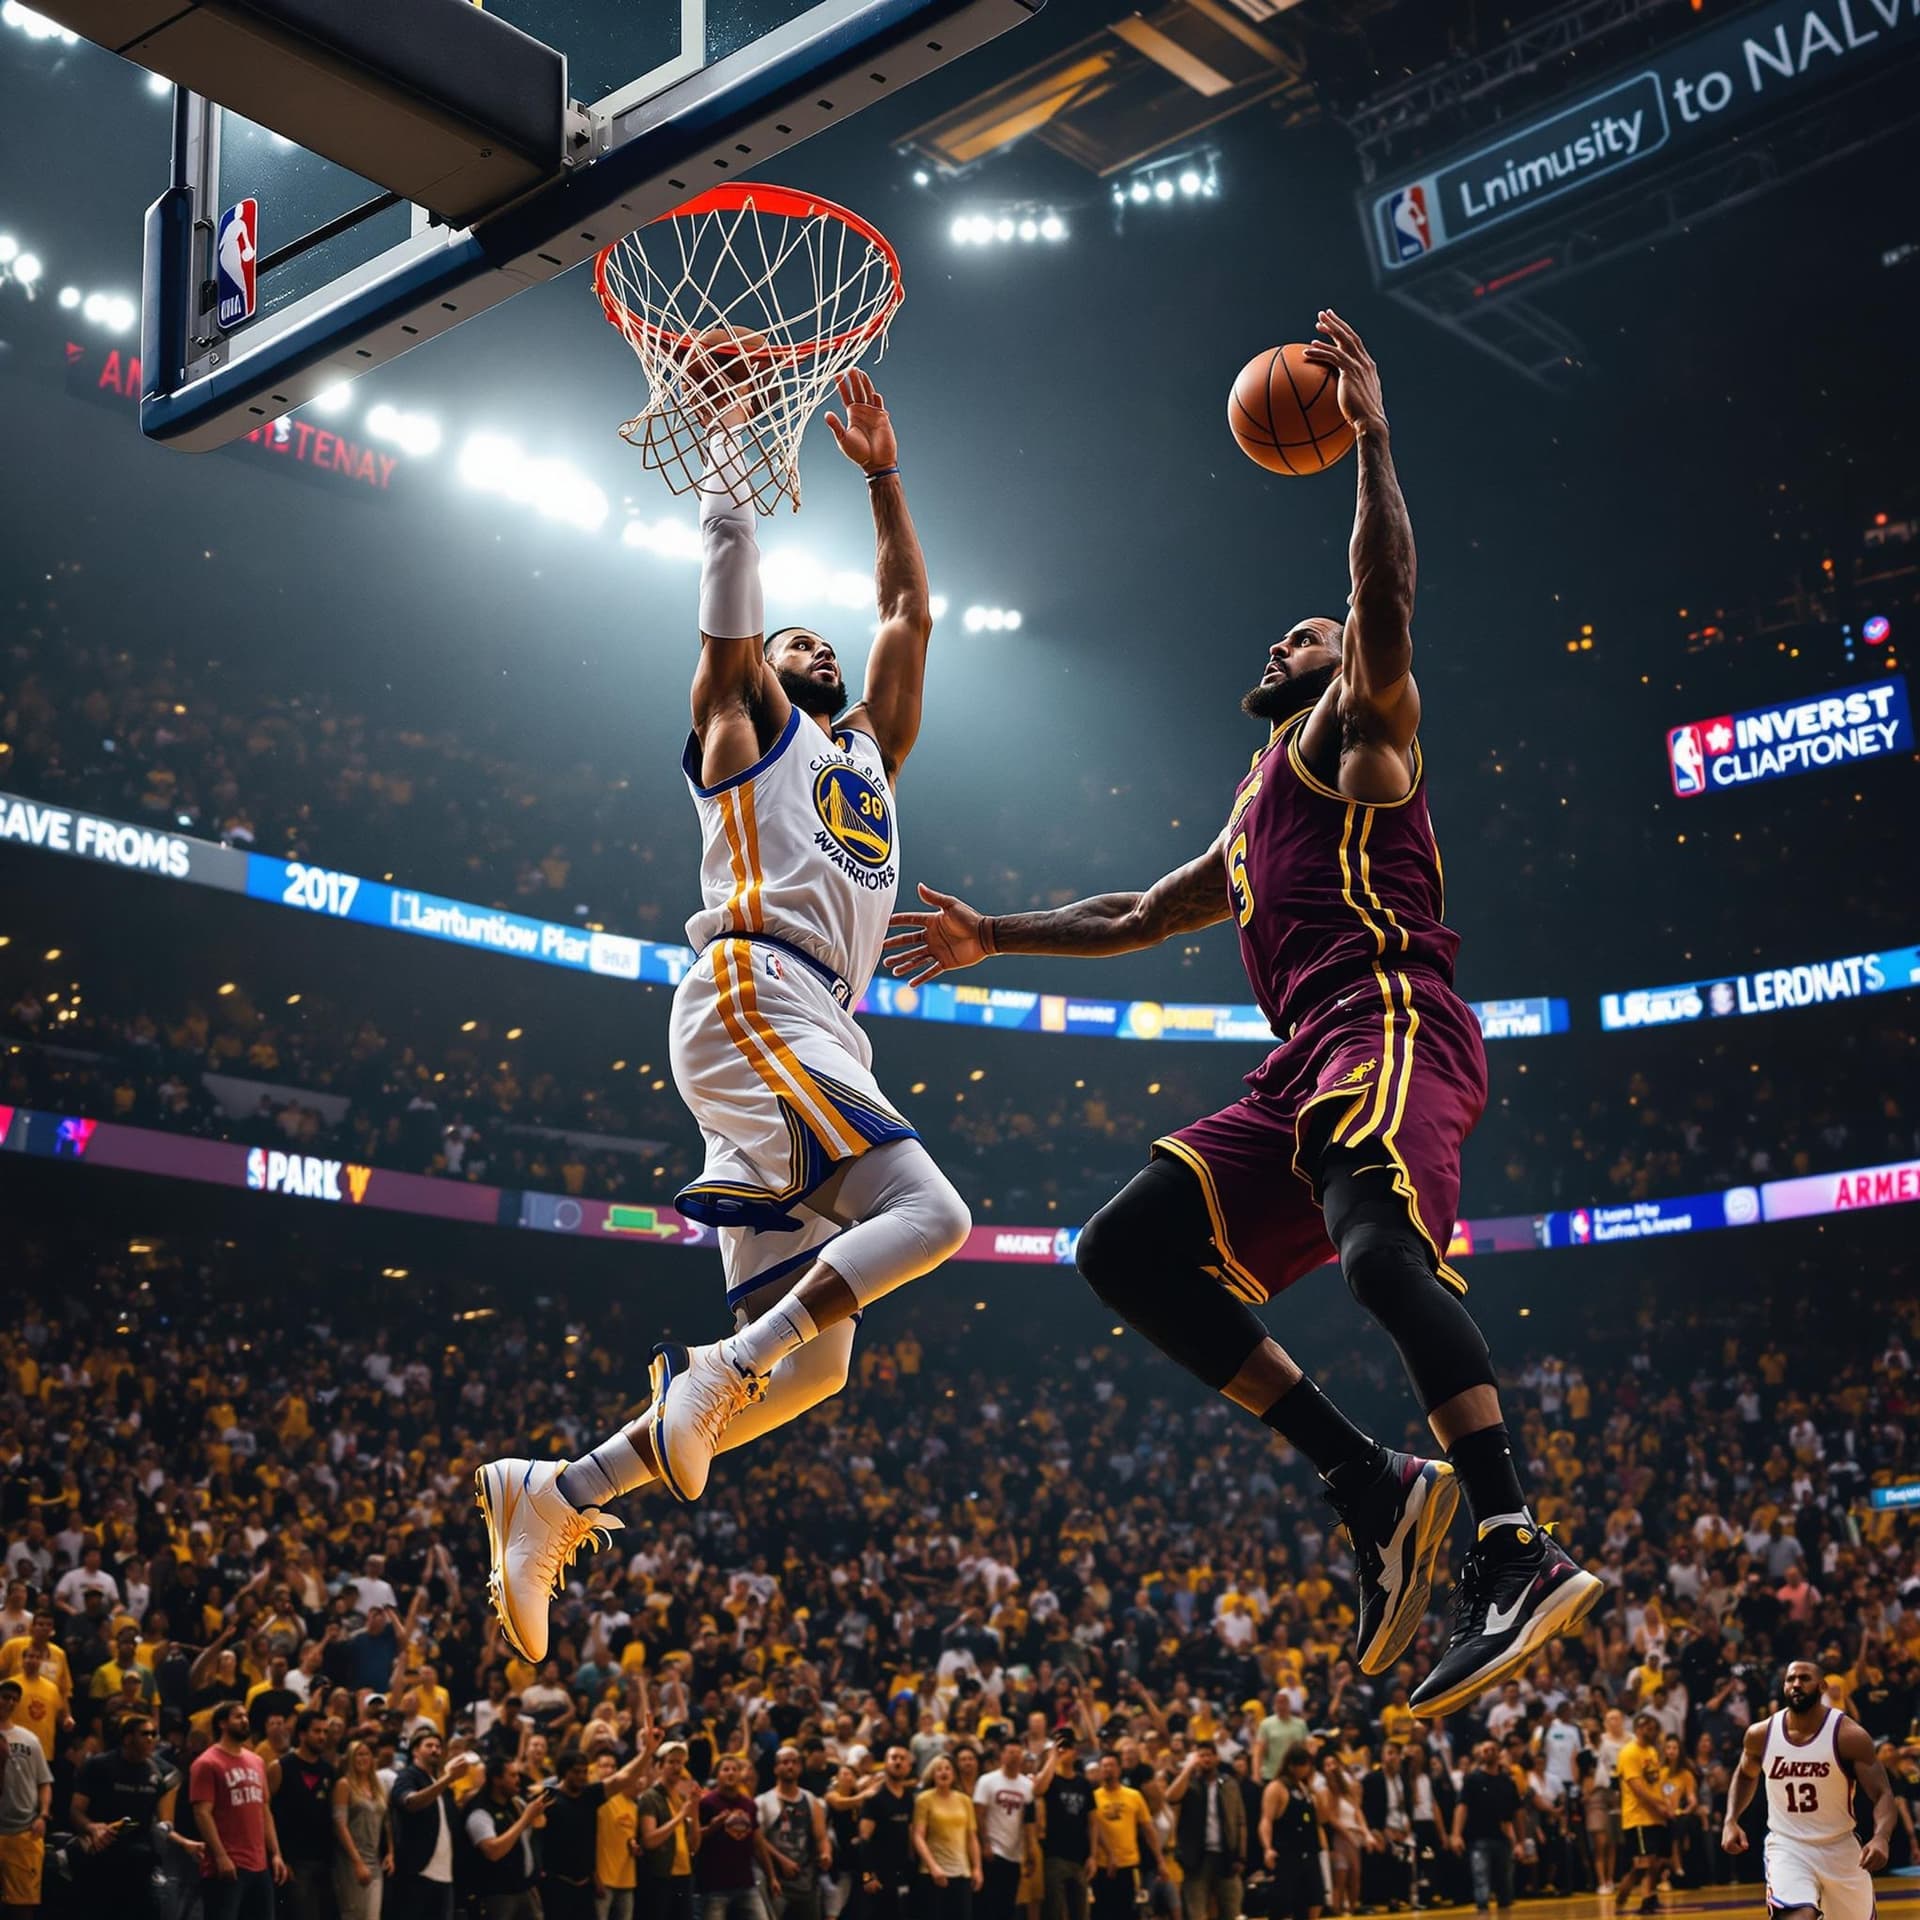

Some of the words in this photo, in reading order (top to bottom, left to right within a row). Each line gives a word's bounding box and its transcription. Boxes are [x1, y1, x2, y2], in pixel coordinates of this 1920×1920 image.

[1460, 109, 1643, 217] Lnimusity
[1673, 70, 1732, 122] to
[1735, 685, 1894, 749] INVERST
[76, 816, 190, 878] FROMS
[283, 862, 360, 916] 2017
[1835, 1168, 1920, 1212] ARME
[1785, 1782, 1818, 1813] 13
